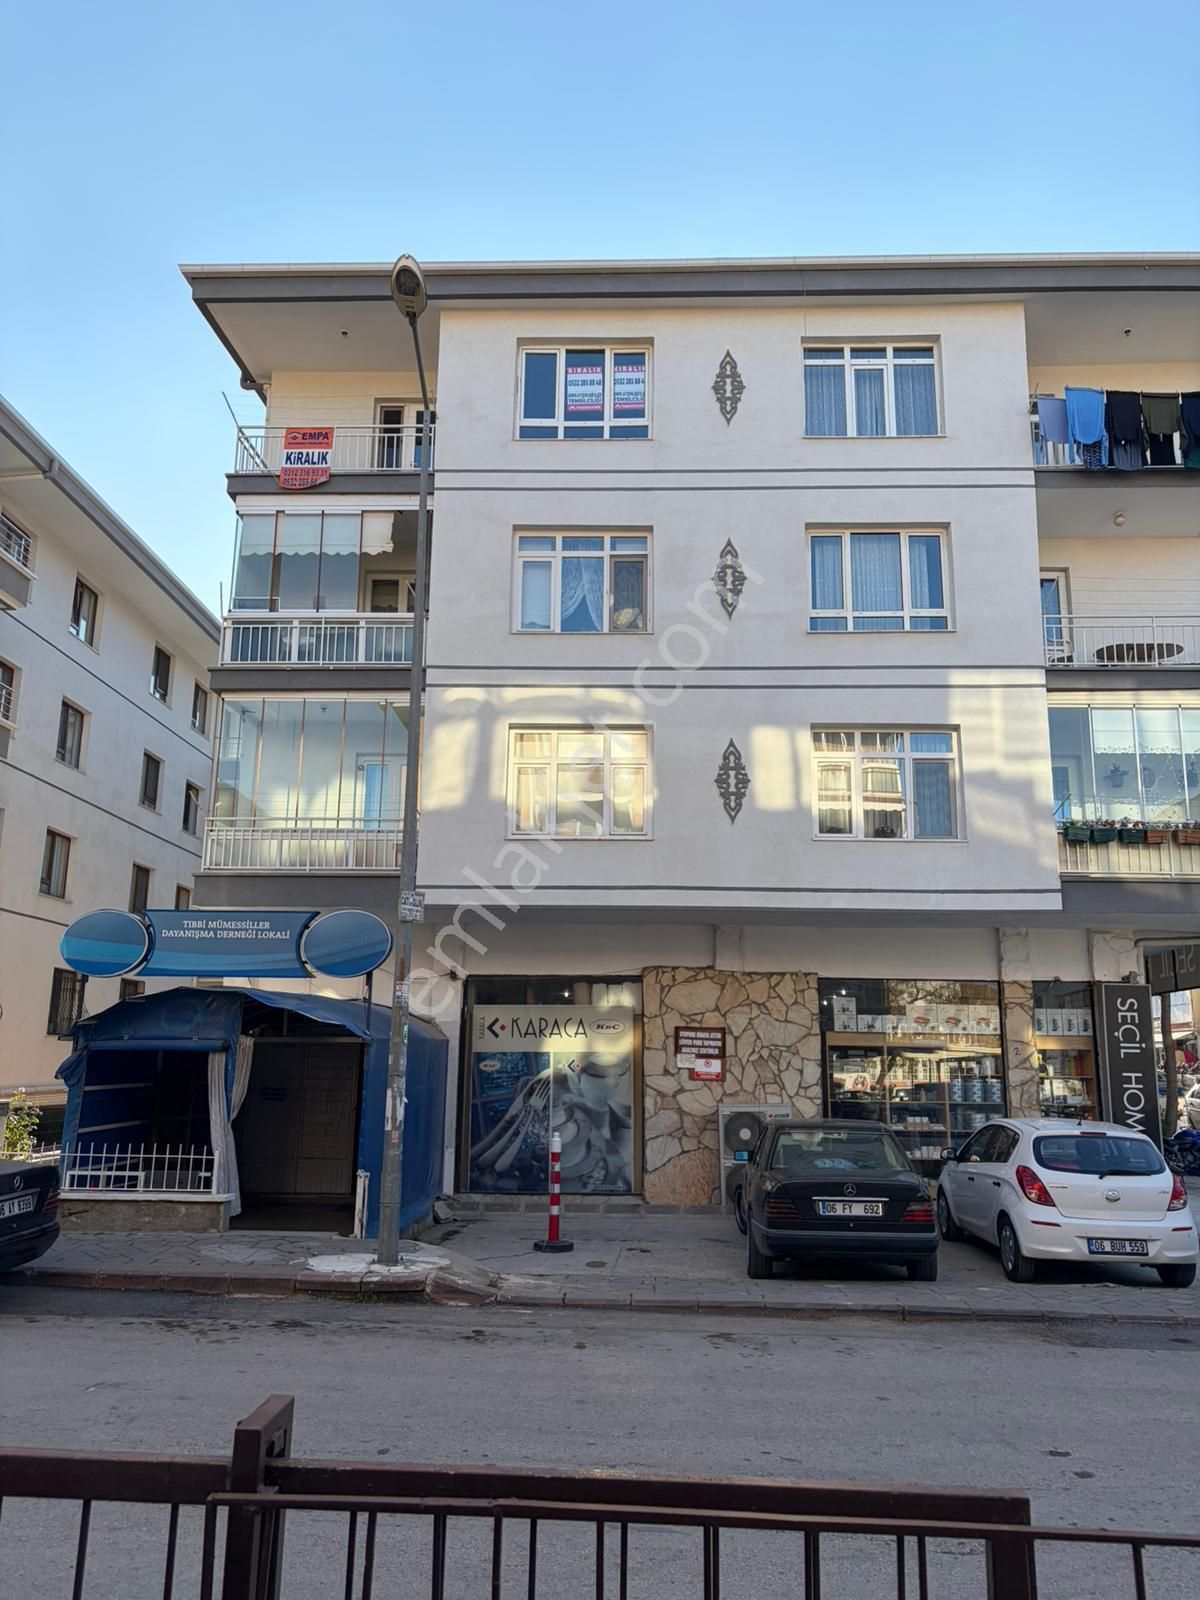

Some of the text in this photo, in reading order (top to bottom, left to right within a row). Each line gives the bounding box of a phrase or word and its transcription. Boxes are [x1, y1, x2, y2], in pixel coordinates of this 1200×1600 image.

[301, 431, 329, 441] EMPA
[208, 919, 270, 929] MÜMESSİLLER
[161, 929, 290, 940] DAYANIŞMA DERNEĞİ LOKALİ
[511, 1016, 589, 1039] KARACA
[1113, 998, 1147, 1060] SEÇİL
[1013, 1047, 1021, 1056] 2
[826, 1203, 880, 1215] 06 FY 692
[1094, 1240, 1145, 1253] 06 BUH 559
